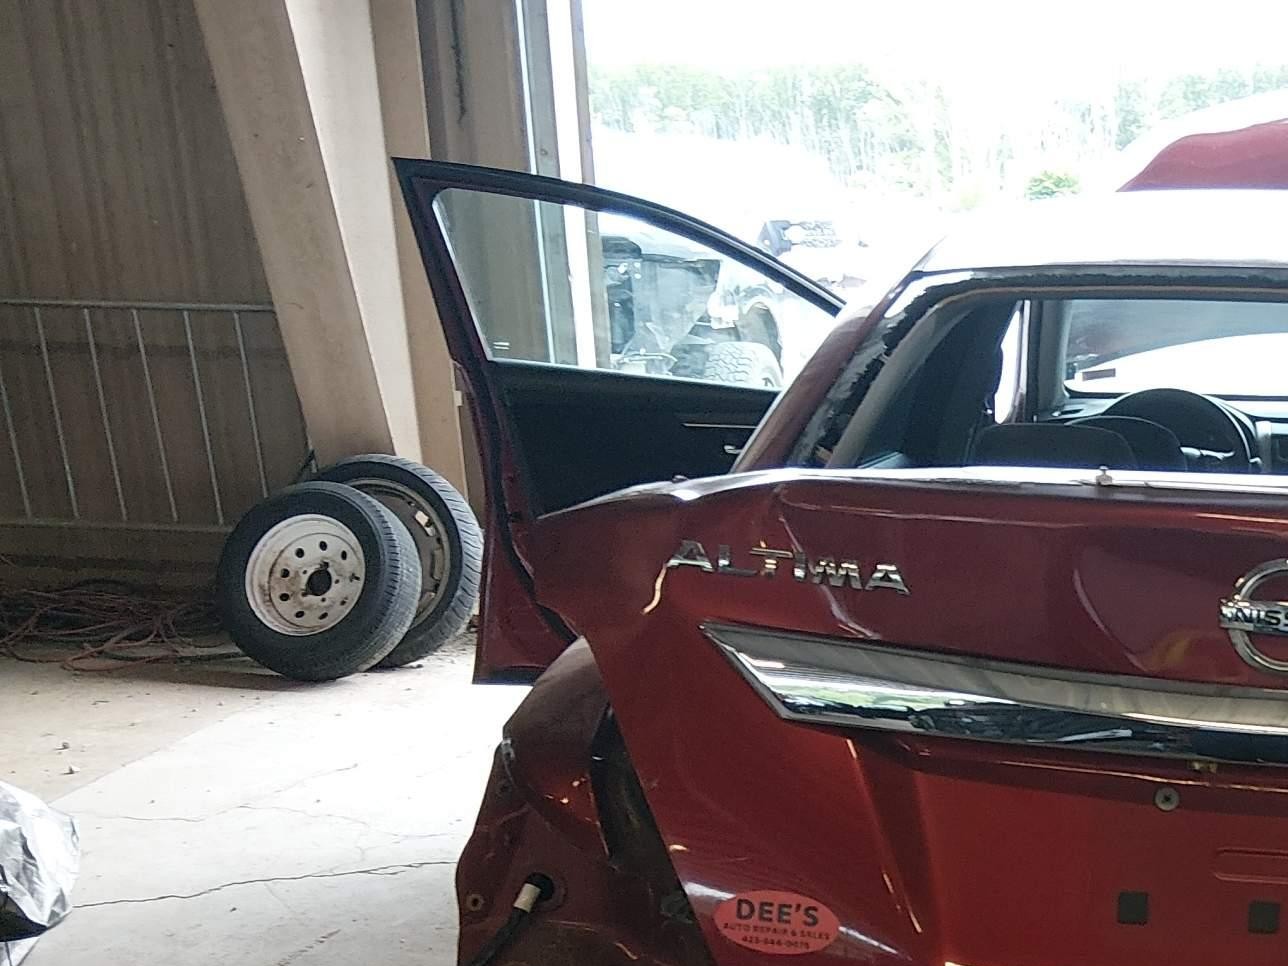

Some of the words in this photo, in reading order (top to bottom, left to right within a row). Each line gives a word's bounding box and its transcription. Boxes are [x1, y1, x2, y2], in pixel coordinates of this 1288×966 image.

[667, 540, 911, 595] ALTIMA
[736, 898, 819, 927] DEE'S
[723, 922, 751, 932] AUTO
[752, 925, 788, 935] REPAIR
